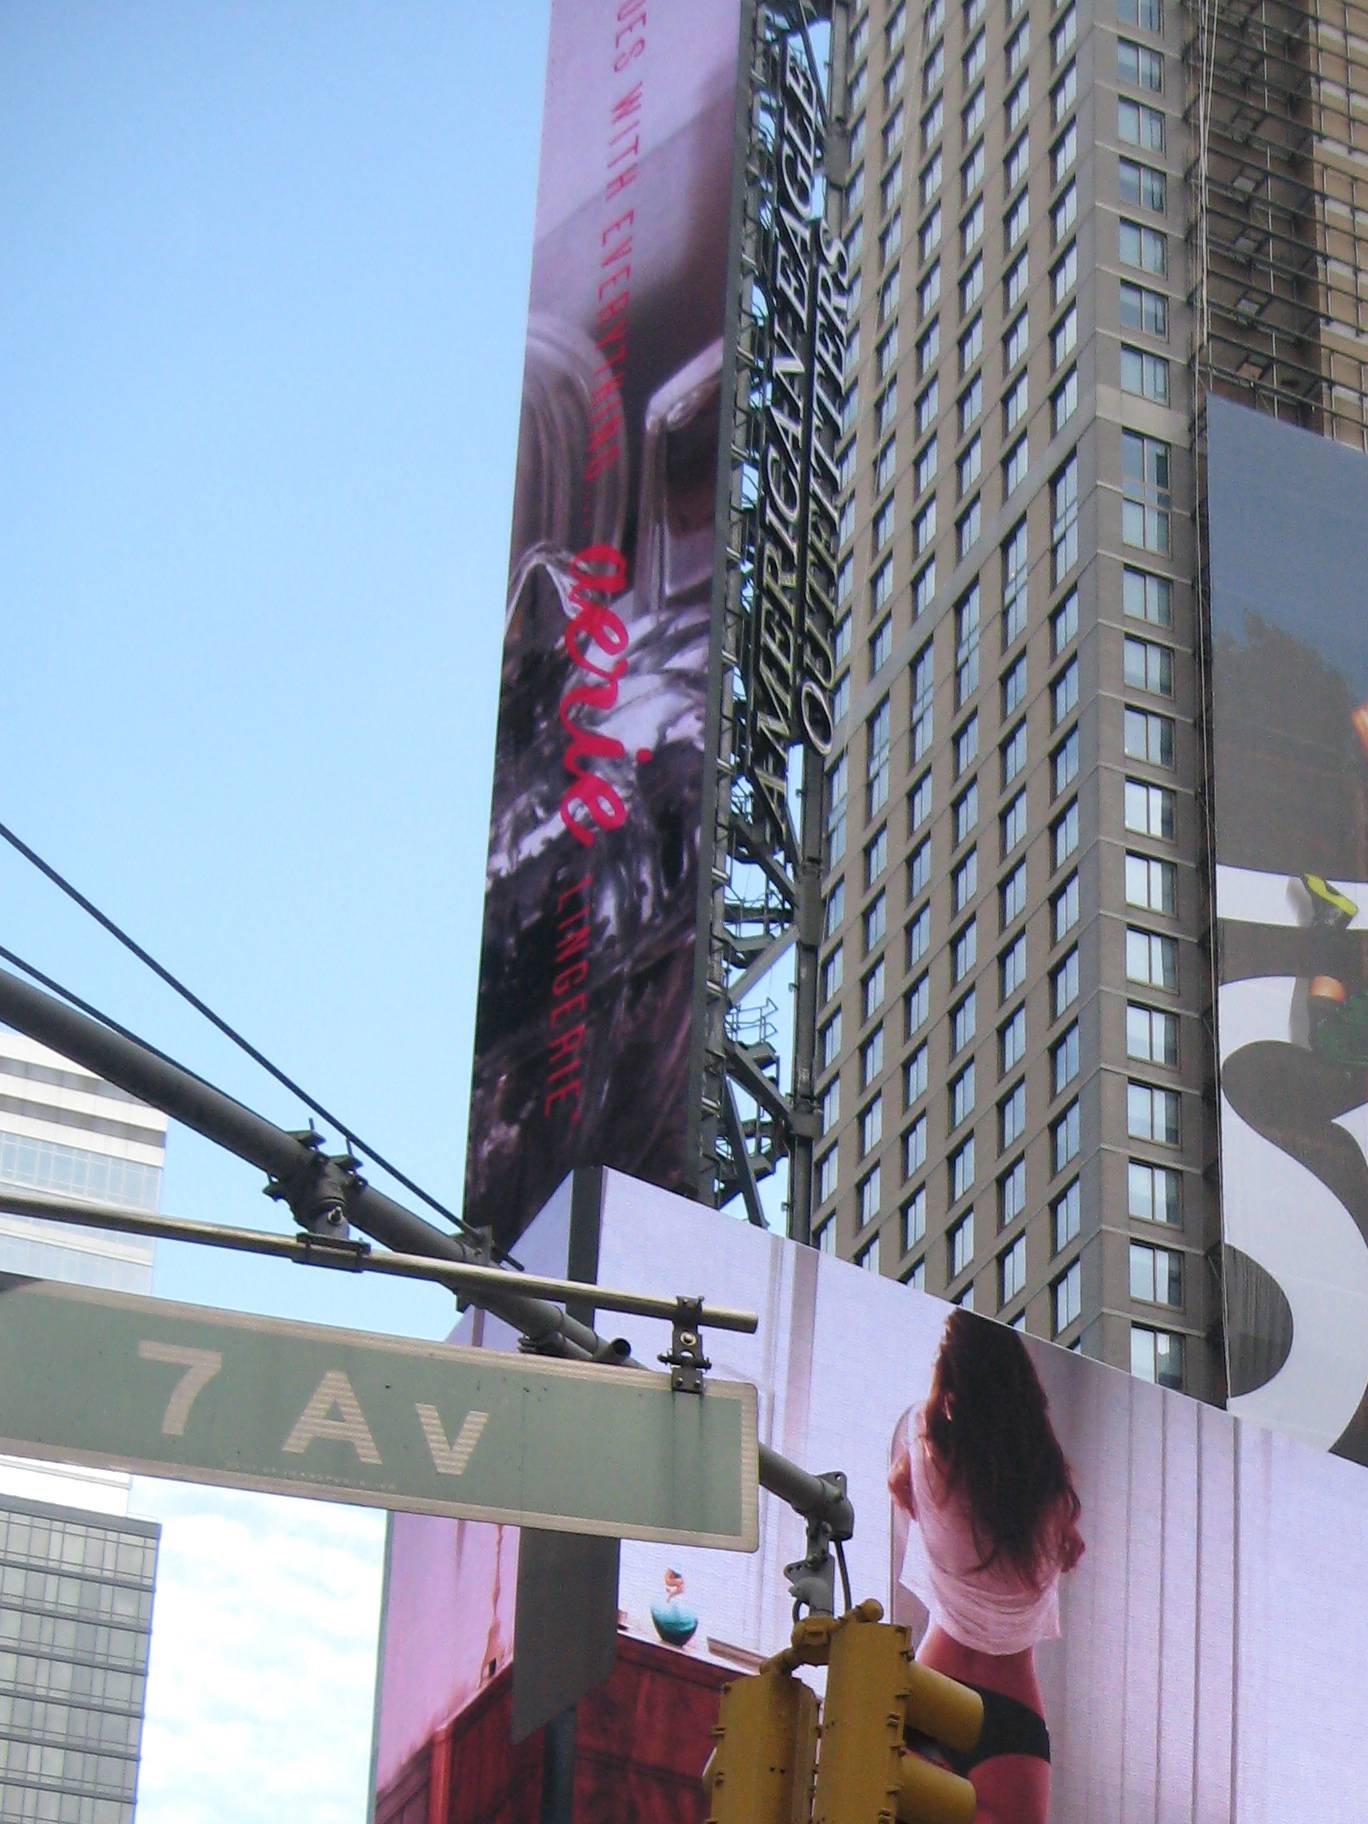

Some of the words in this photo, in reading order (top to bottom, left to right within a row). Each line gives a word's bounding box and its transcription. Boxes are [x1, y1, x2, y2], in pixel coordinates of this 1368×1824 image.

[605, 81, 643, 201] WITH
[776, 45, 816, 332] EAGLE
[751, 319, 806, 841] AMERICAN
[802, 220, 849, 756] OUTFITTERS
[559, 543, 653, 846] aerie
[543, 875, 592, 1123] LINGERIE
[138, 1339, 222, 1436] 7
